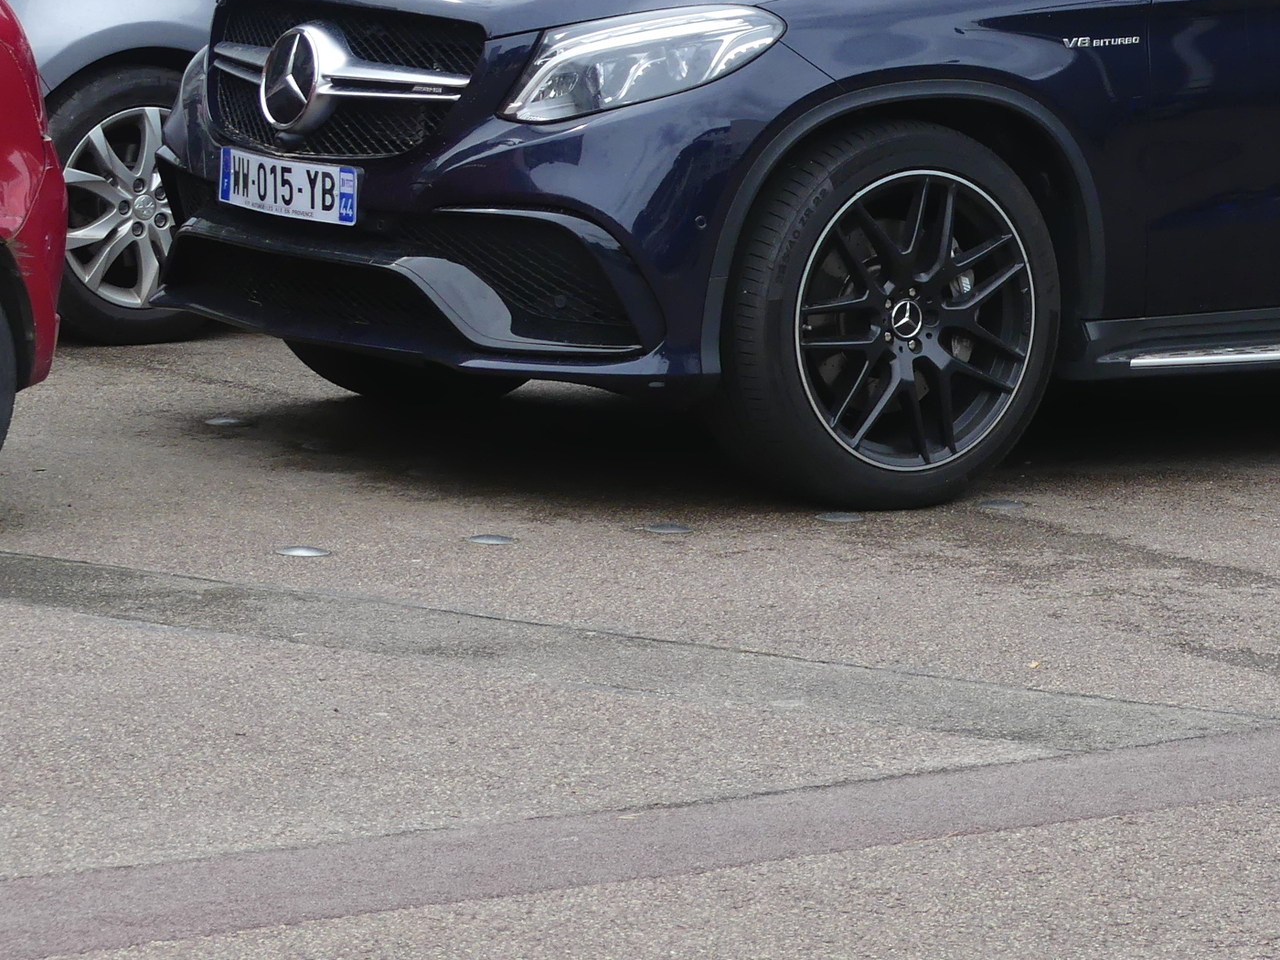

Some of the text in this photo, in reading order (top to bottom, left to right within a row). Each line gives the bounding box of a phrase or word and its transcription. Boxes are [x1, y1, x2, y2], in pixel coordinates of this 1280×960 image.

[1092, 36, 1140, 47] BITURBO
[232, 155, 336, 212] WW-015-YB
[340, 197, 353, 217] 44
